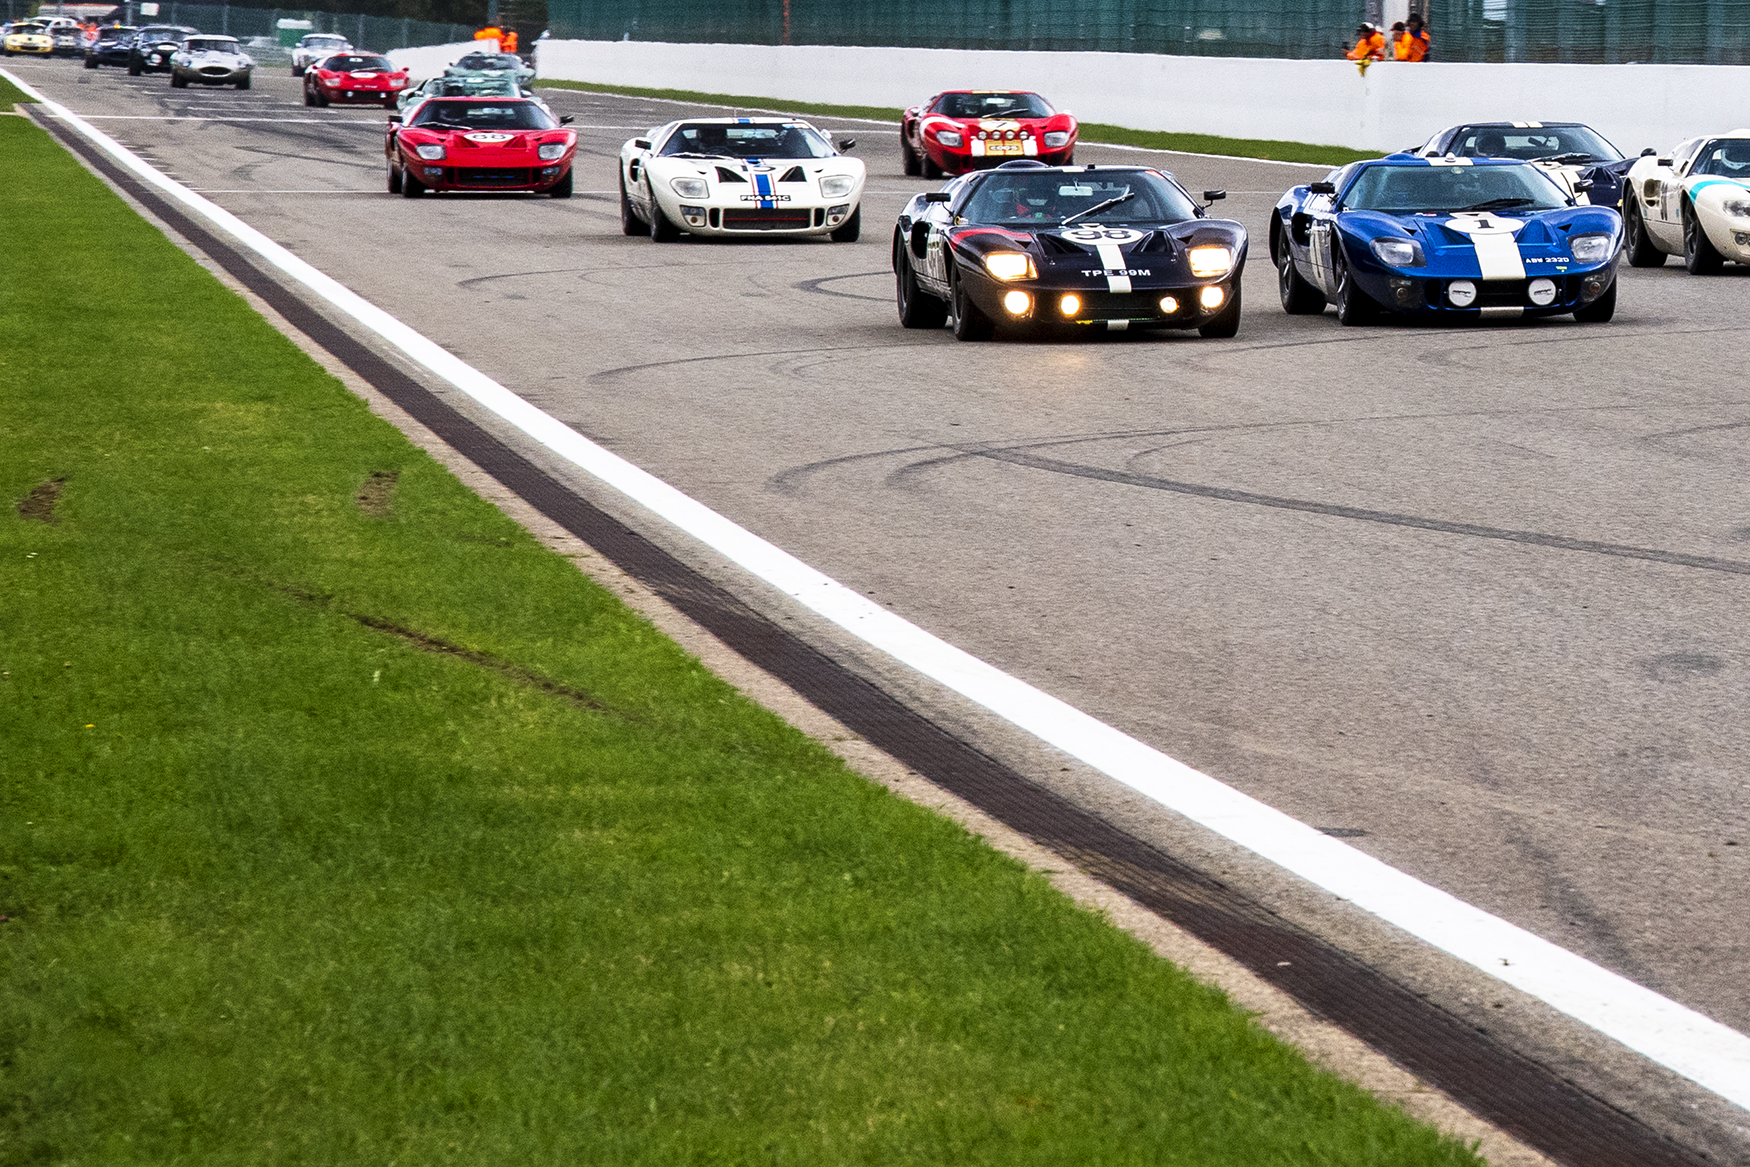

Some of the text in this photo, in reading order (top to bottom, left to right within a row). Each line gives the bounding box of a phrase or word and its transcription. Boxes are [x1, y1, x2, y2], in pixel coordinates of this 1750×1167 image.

[1473, 219, 1495, 229] 1
[1071, 230, 1132, 240] 98
[1080, 269, 1152, 277] TPE 99M
